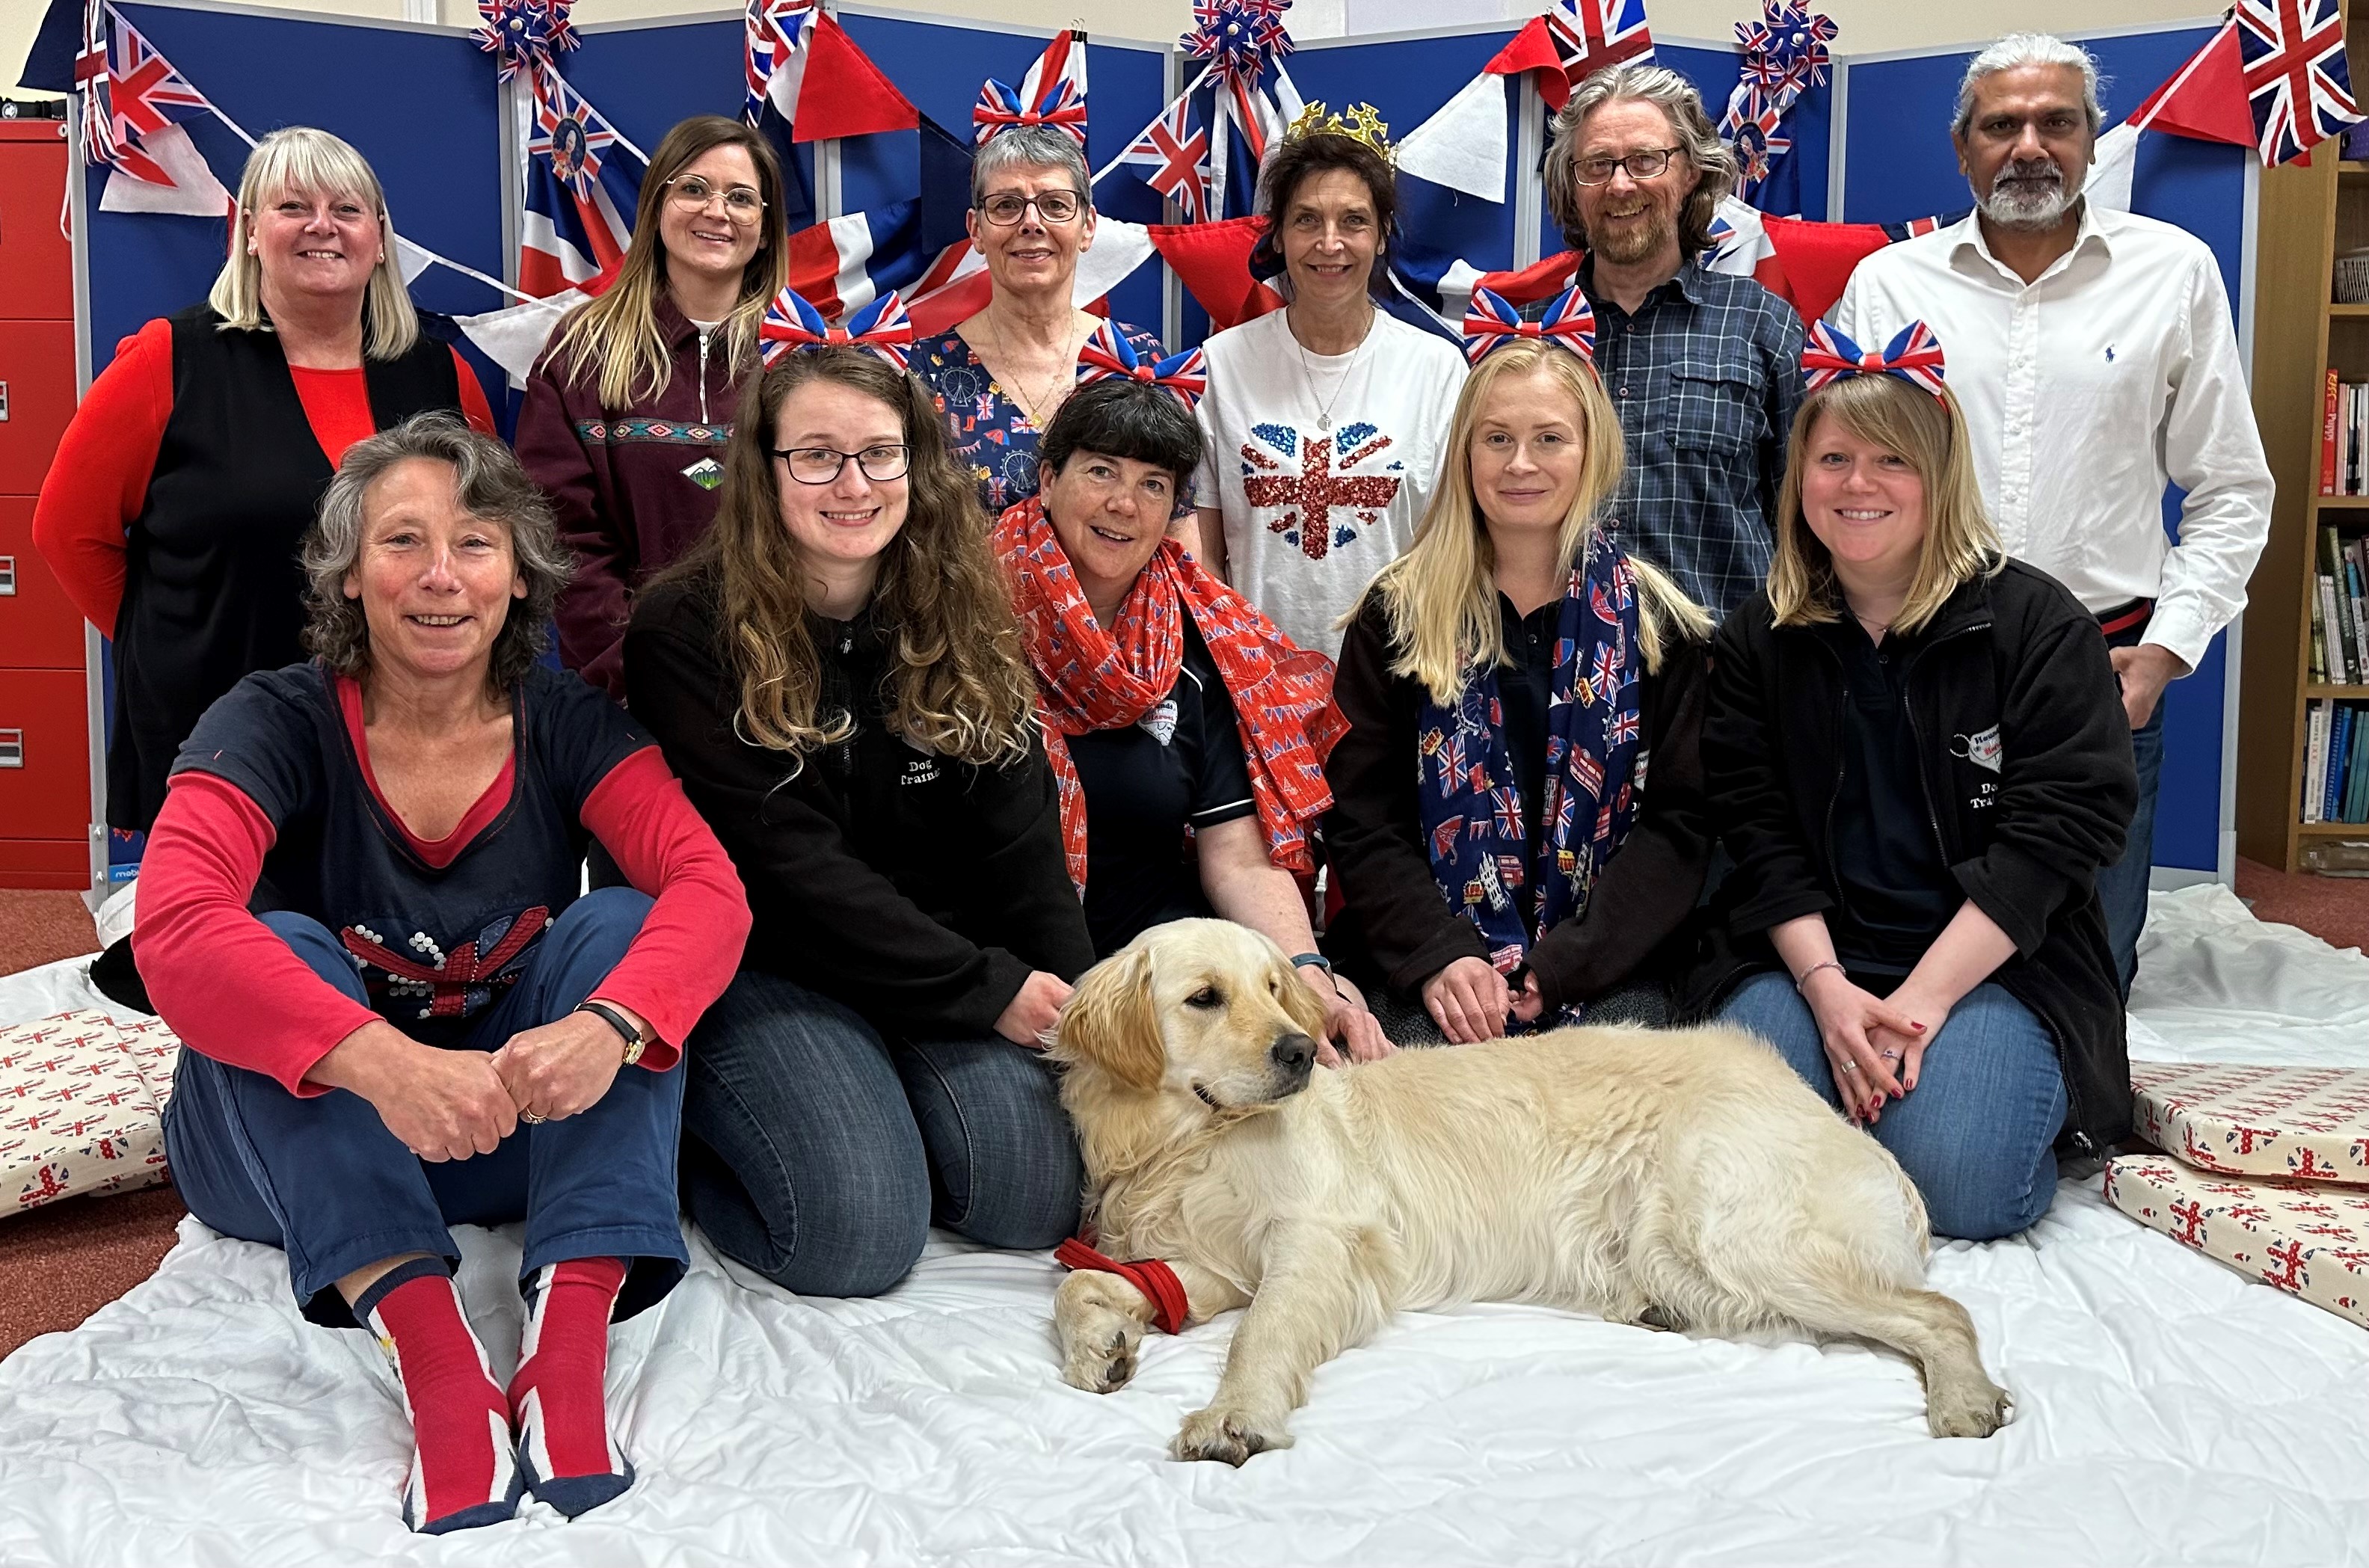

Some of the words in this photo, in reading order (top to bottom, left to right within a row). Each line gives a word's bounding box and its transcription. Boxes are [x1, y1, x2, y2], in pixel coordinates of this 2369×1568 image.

[909, 759, 932, 772] Dog
[900, 767, 941, 785] Traine
[1981, 782, 1999, 794] Do
